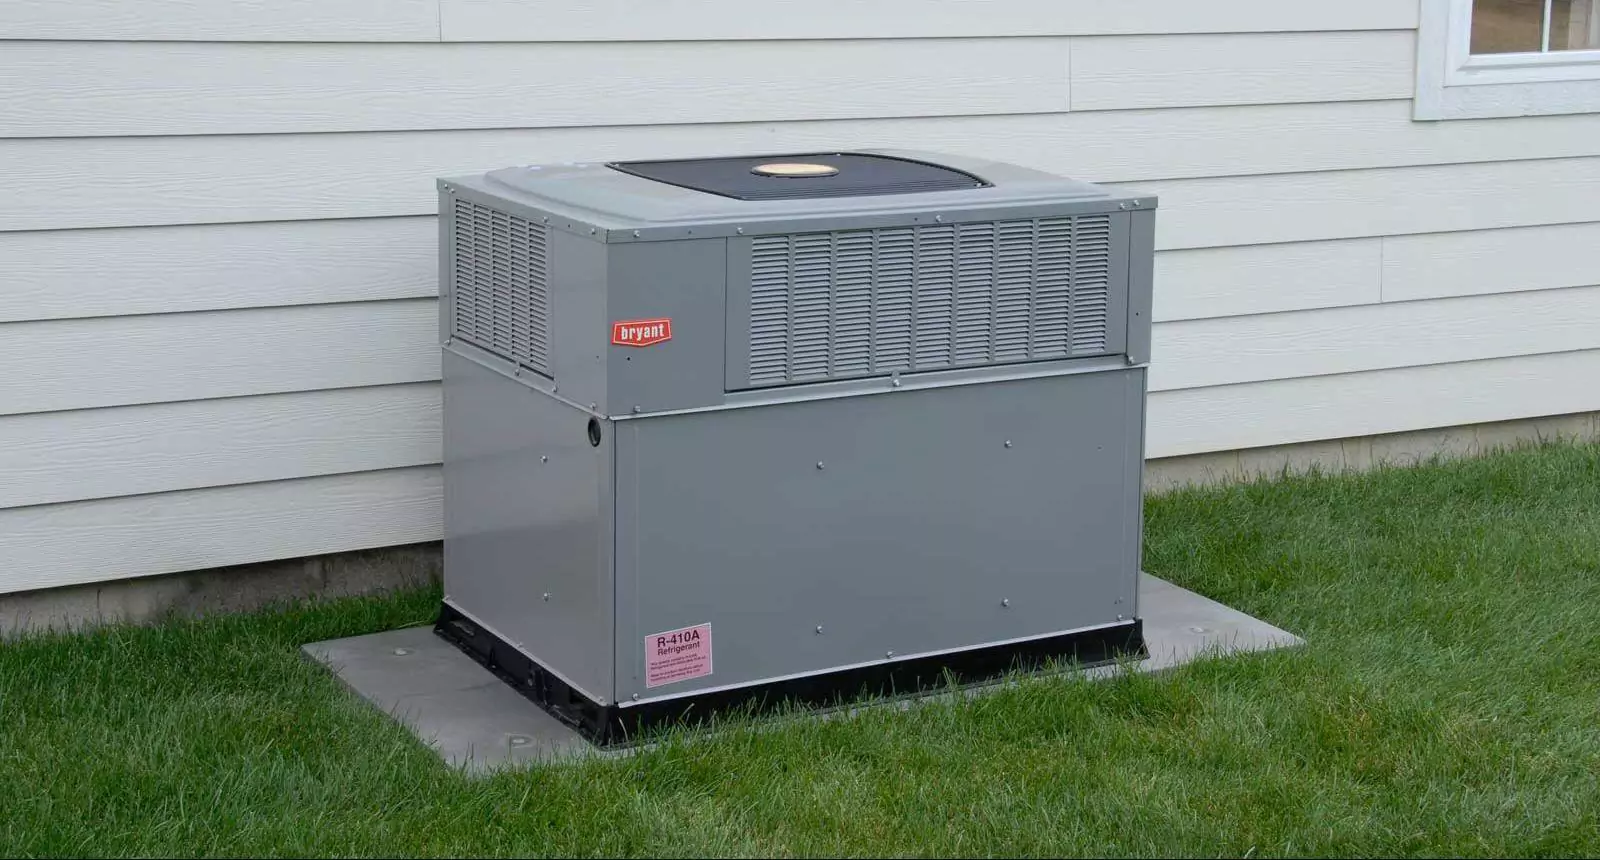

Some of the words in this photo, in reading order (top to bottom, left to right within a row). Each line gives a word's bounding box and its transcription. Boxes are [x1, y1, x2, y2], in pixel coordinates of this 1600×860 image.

[621, 323, 665, 341] bryant
[657, 629, 700, 648] R-410A
[657, 641, 700, 656] Refrigerant
